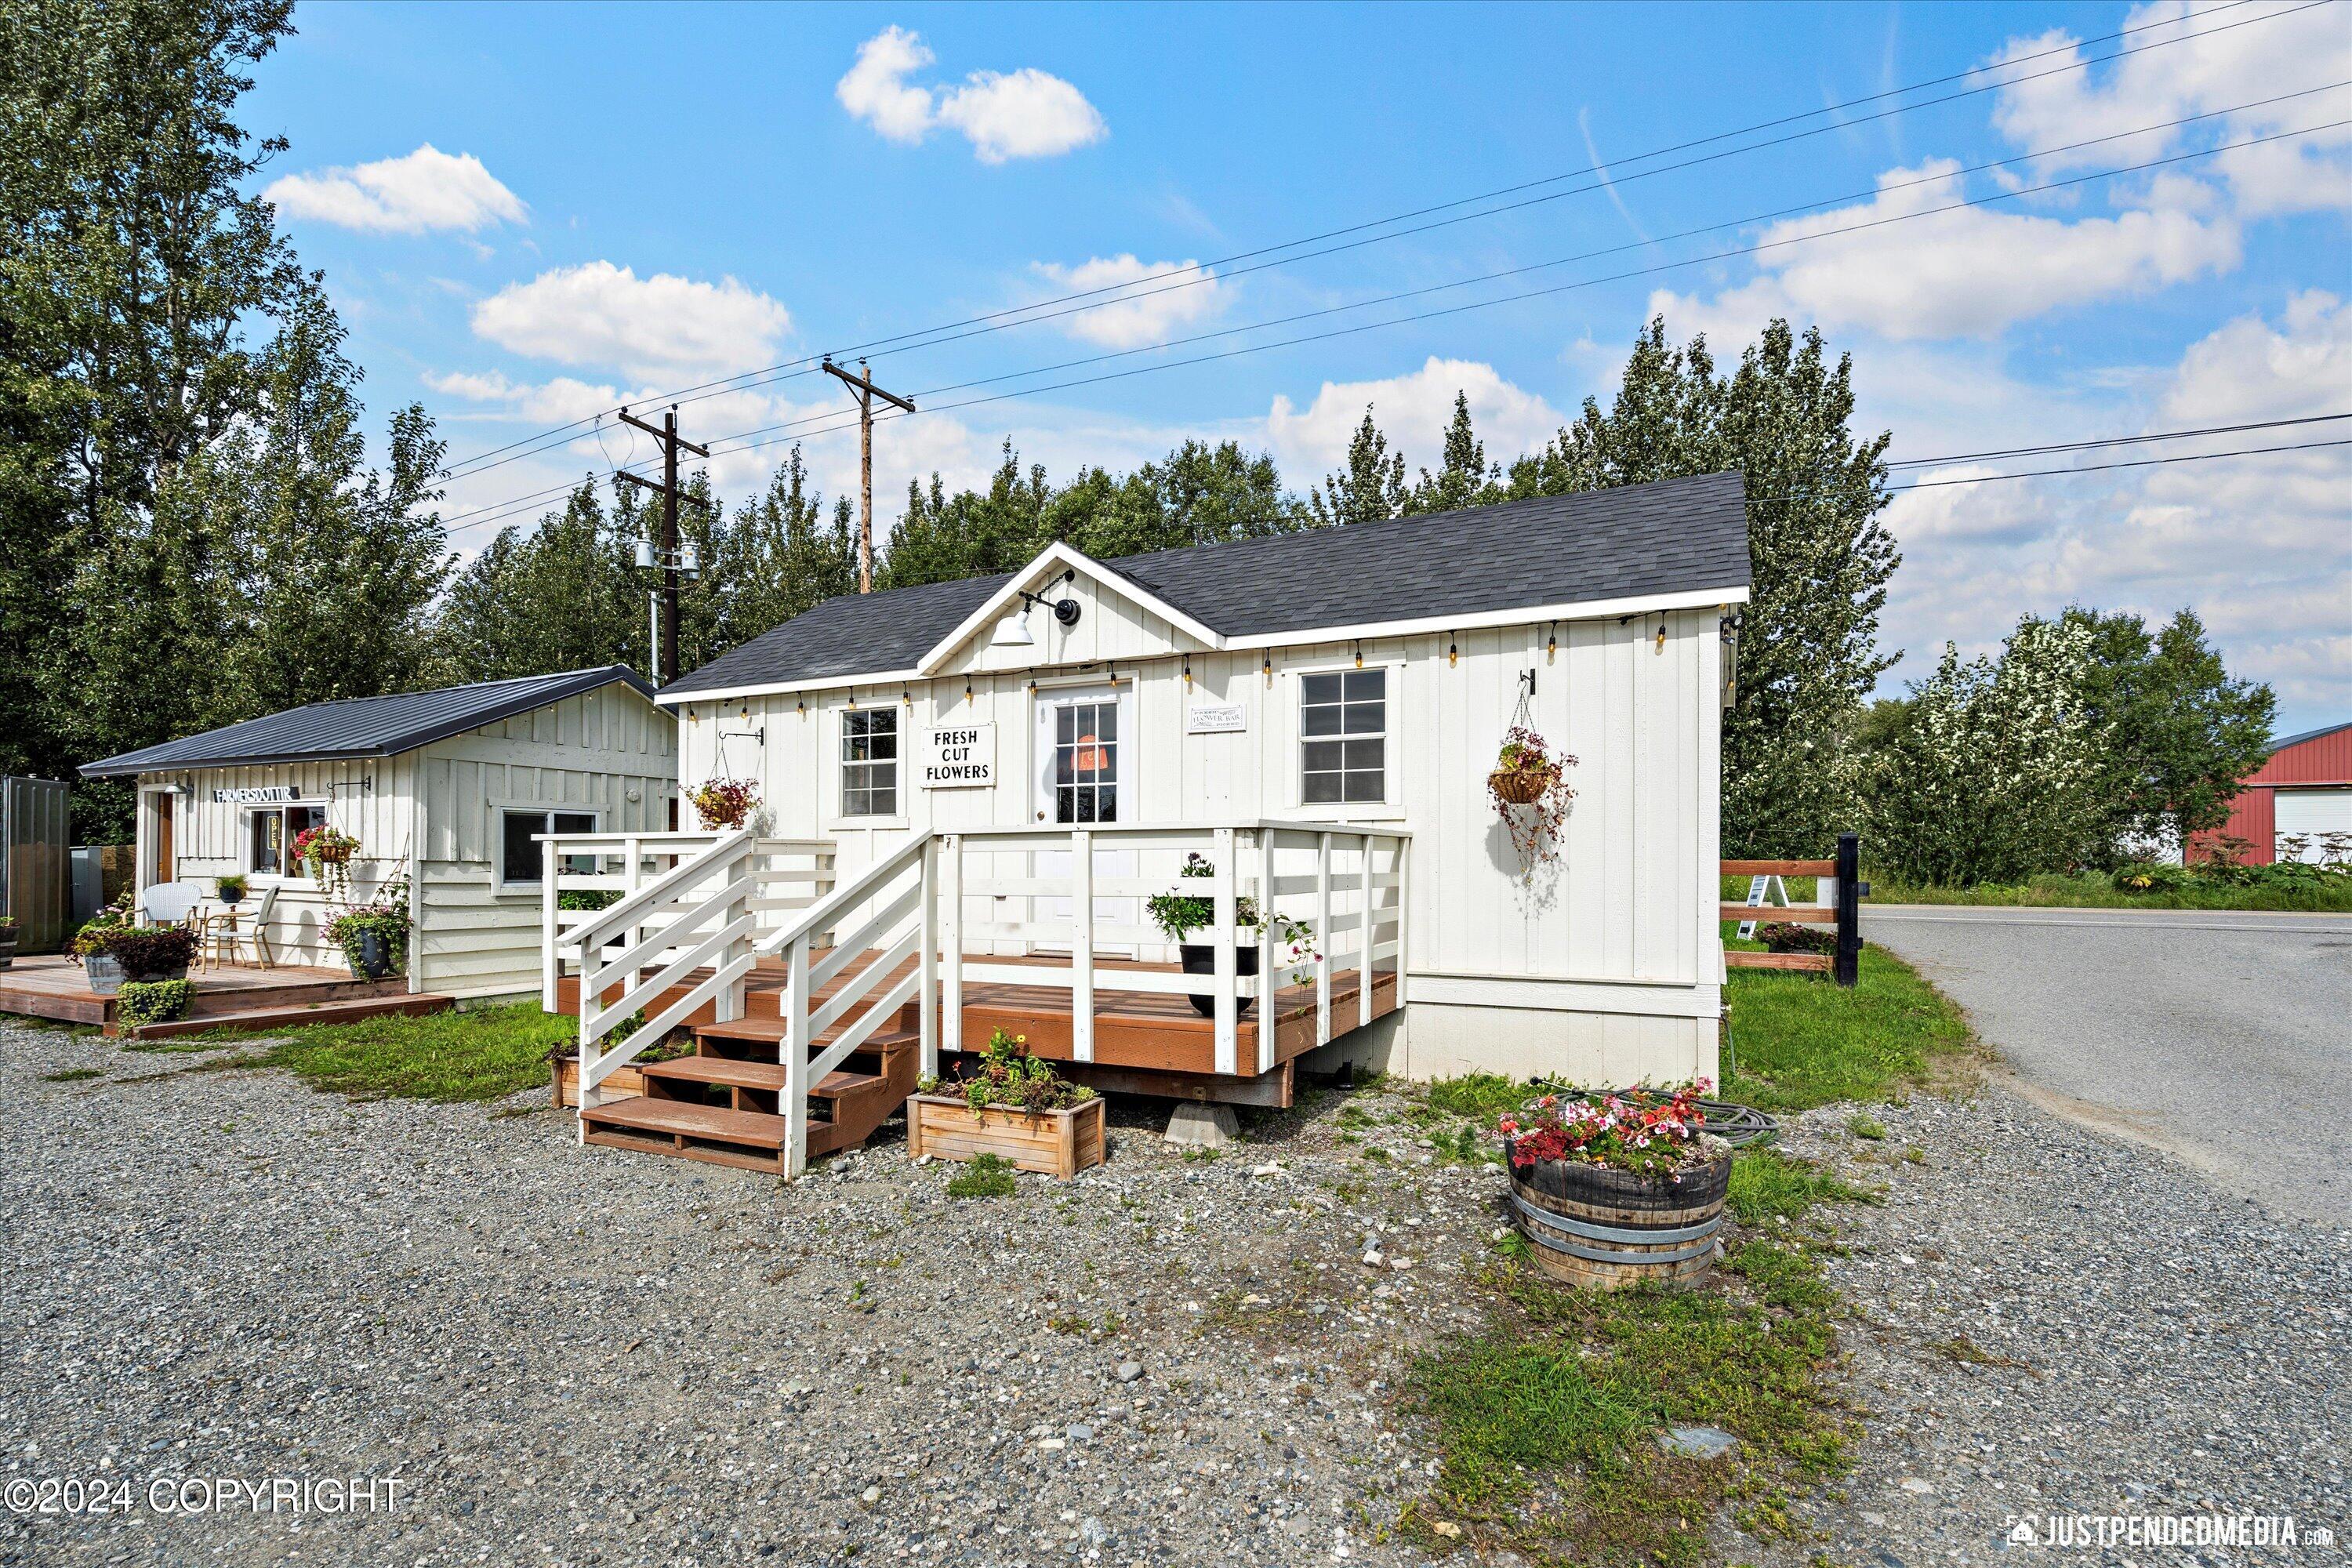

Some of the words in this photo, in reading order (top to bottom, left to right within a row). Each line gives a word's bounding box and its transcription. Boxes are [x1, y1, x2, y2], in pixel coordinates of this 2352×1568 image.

[935, 731, 977, 746] FRESH
[942, 747, 970, 762] CUT
[927, 764, 989, 780] FLOWERS
[216, 786, 292, 803] FARMERSDOTTIR
